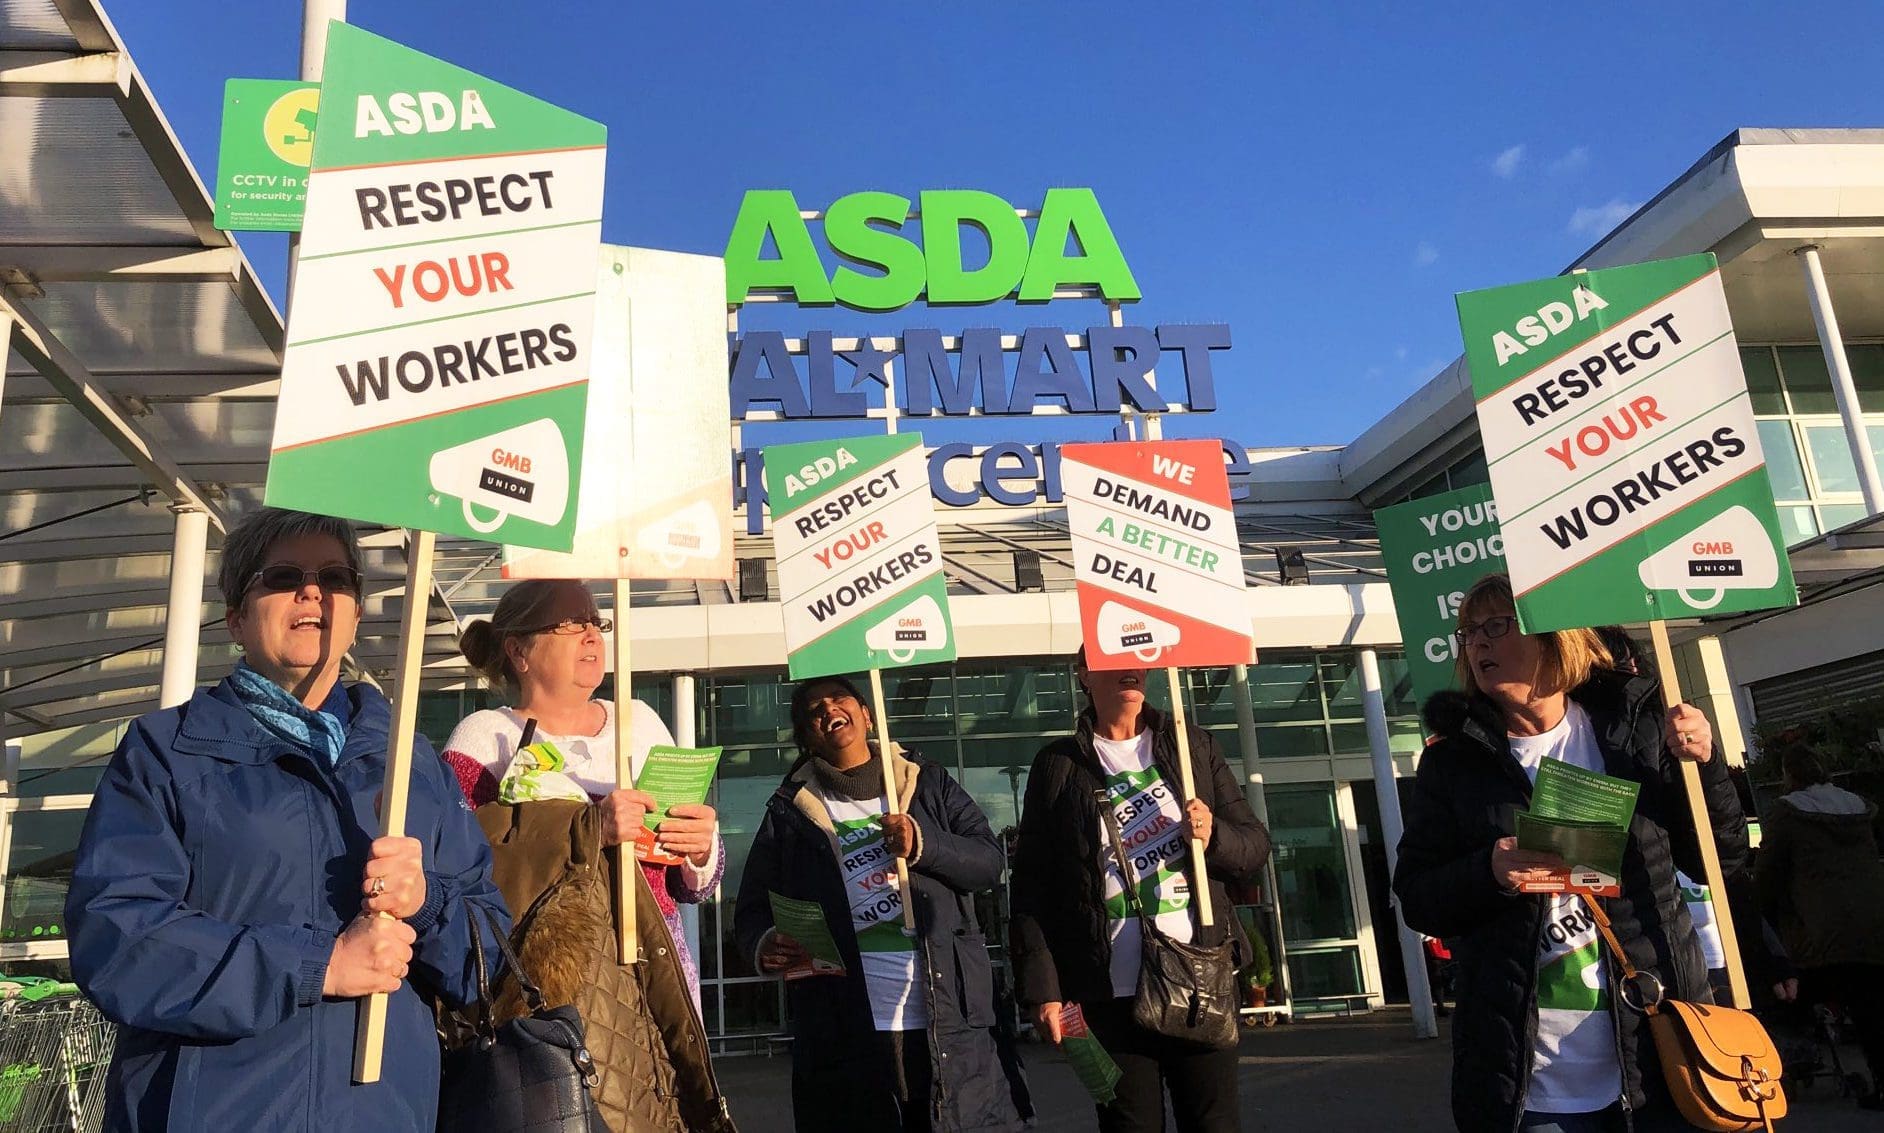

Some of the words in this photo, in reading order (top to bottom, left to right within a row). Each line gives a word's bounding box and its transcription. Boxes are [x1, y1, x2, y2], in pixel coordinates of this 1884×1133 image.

[354, 89, 496, 138] ASDA
[231, 190, 247, 199] for
[250, 191, 292, 202] security
[233, 174, 277, 186] CCTV
[282, 176, 297, 187] in
[355, 170, 554, 231] RESPECT
[724, 188, 1143, 311] ASDA
[372, 251, 515, 309] YOUR
[1491, 283, 1609, 367] ASDA
[335, 323, 578, 407] WORKERS
[1512, 313, 1685, 427] RESPECT
[1544, 394, 1667, 472] YOUR
[486, 476, 527, 495] UNION
[491, 448, 532, 475] GMB
[784, 447, 858, 498] ASDA
[1152, 454, 1196, 485] WE
[794, 468, 900, 539] RESPECT
[1093, 477, 1211, 532] DEMAND
[1539, 427, 1746, 550] WORKERS
[1419, 500, 1500, 536] YOUR
[813, 521, 888, 570] YOUR
[1096, 516, 1115, 538] A
[1121, 523, 1219, 573] BETTER
[1412, 534, 1505, 574] CHOIC
[1692, 542, 1734, 555] GMB
[1695, 564, 1736, 572] UNION
[808, 543, 933, 623] WORKERS
[1091, 553, 1158, 594] DEAL
[898, 618, 922, 627] GMB
[1121, 621, 1146, 633] GMB
[1107, 775, 1142, 798] SDA
[1115, 782, 1170, 826] ESPECT
